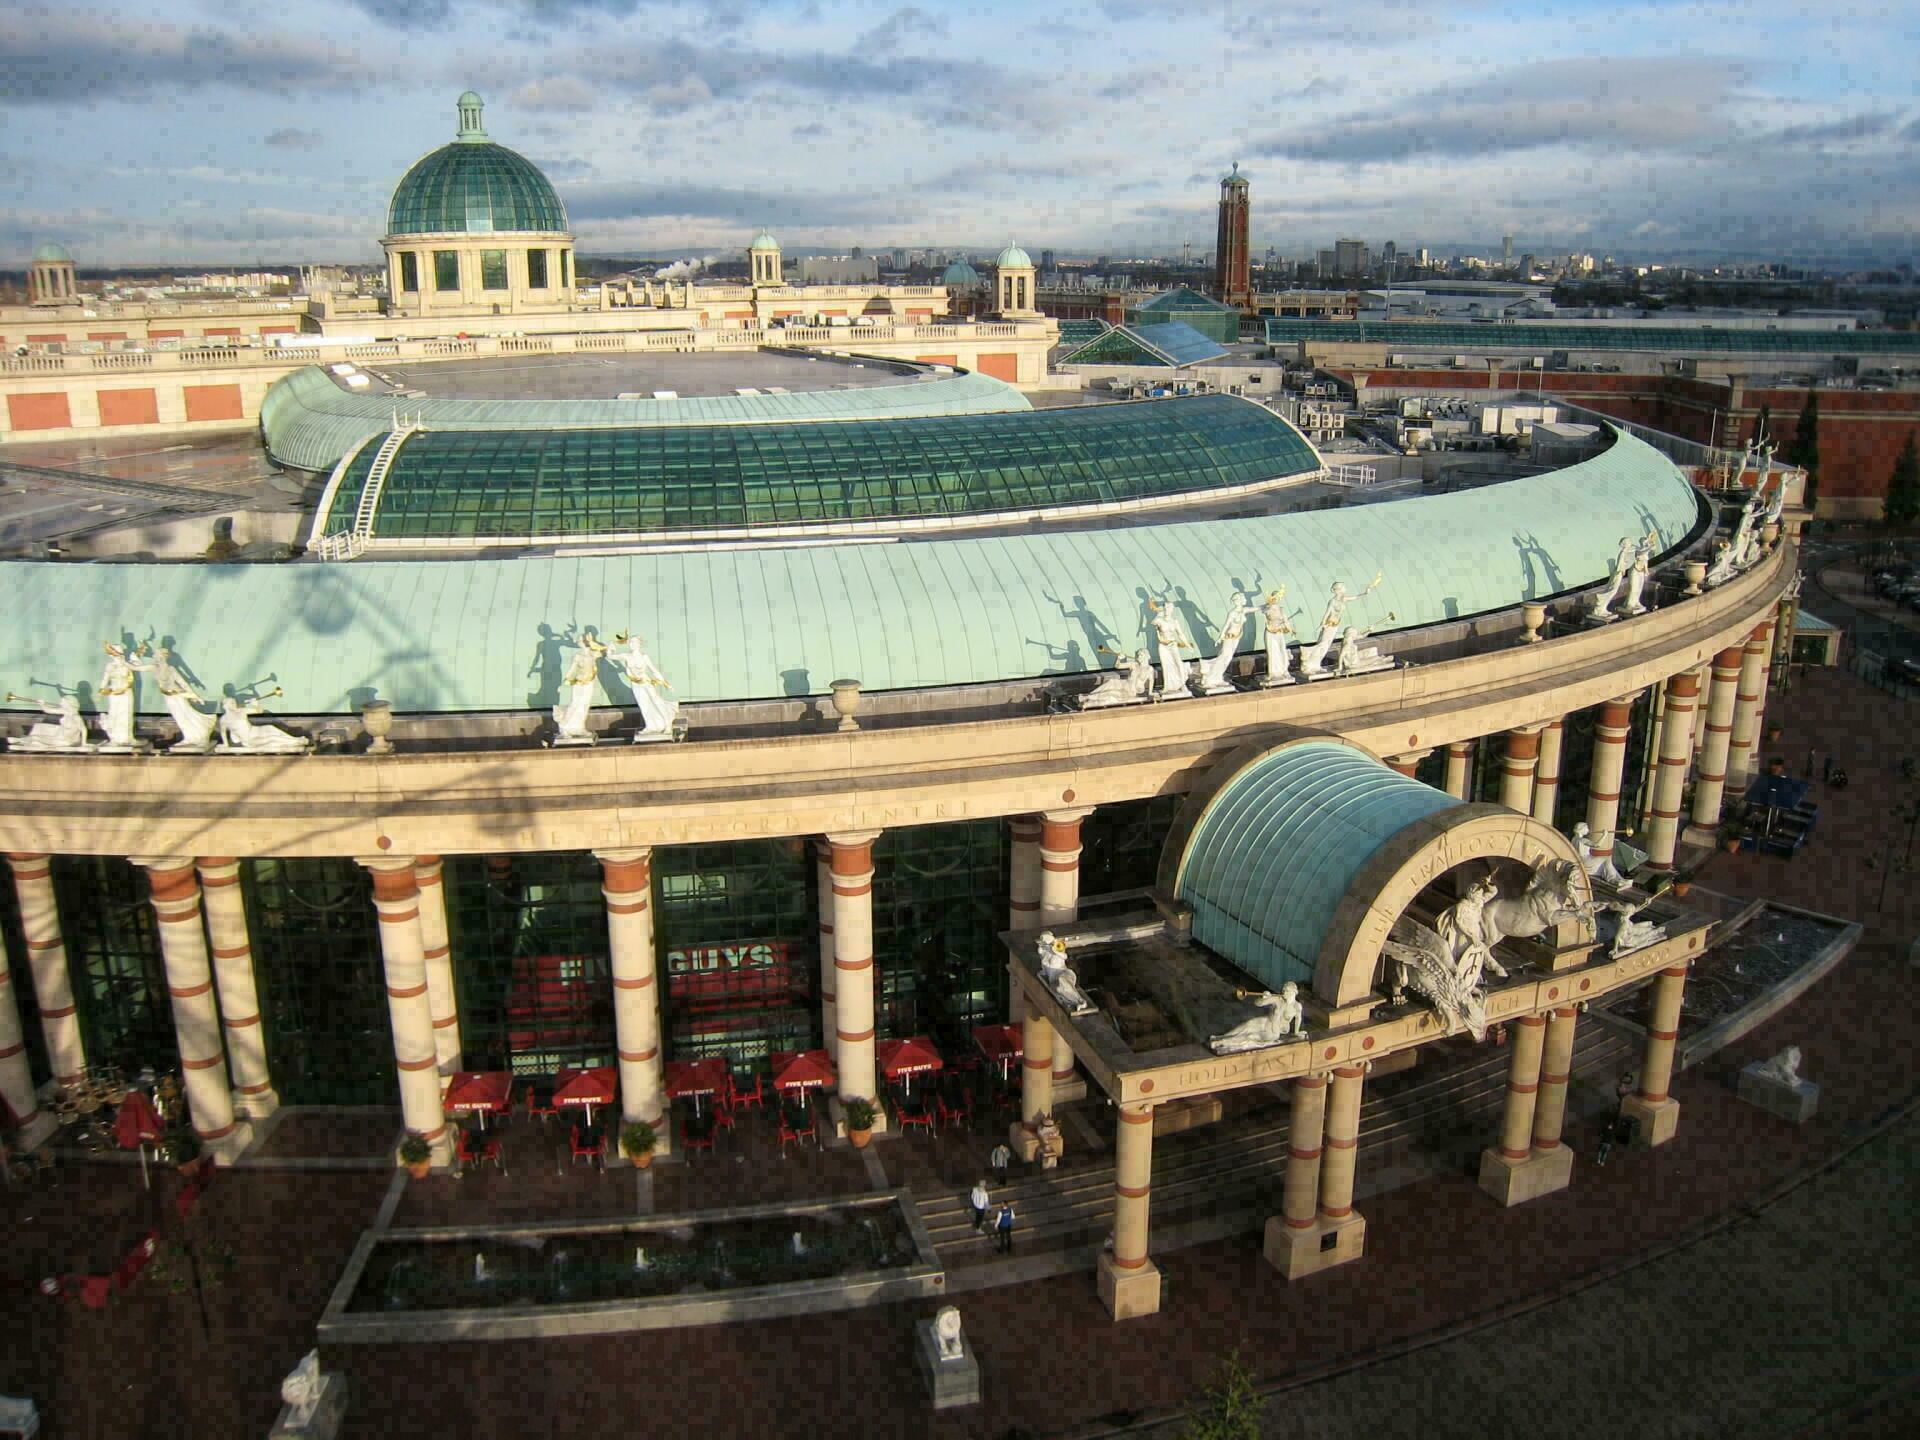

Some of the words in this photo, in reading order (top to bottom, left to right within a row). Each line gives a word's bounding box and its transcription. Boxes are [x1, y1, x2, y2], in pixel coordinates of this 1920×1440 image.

[667, 945, 775, 973] GUYS
[897, 1066, 913, 1075] FIVE
[1177, 1063, 1238, 1086] HOLD
[1248, 1052, 1298, 1078] FAST
